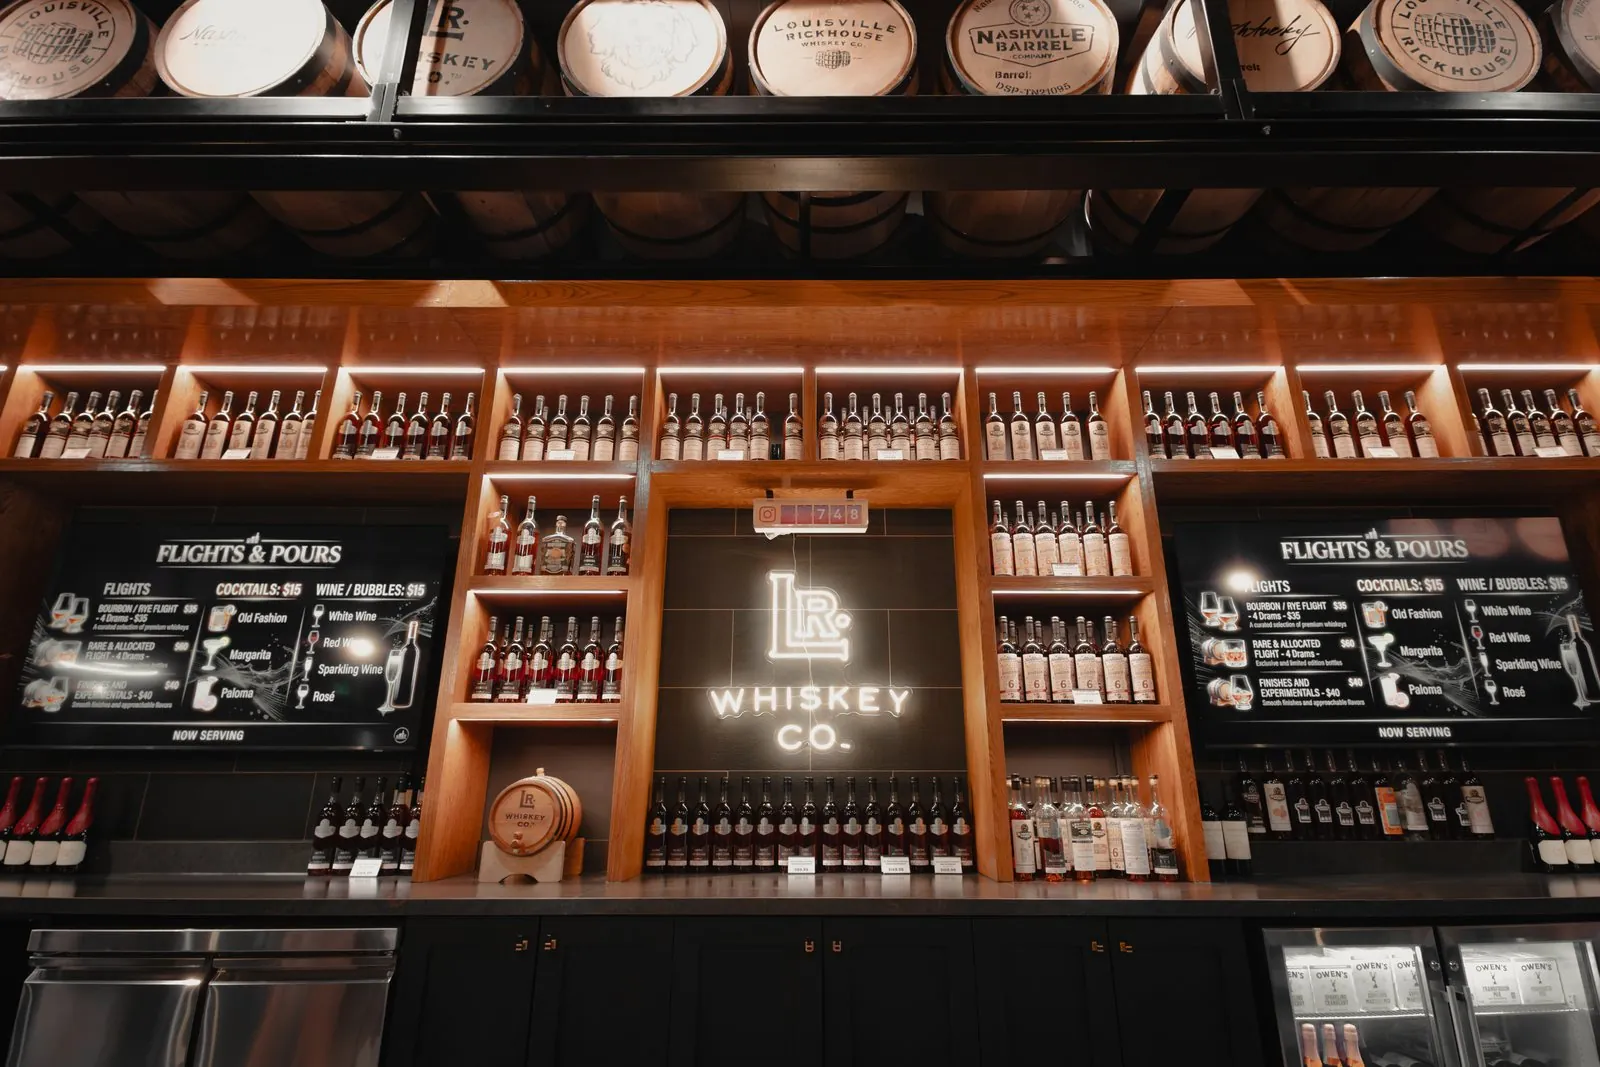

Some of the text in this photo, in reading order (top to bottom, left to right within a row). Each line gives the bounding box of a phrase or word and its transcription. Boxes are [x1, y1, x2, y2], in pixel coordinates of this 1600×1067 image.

[1399, 0, 1506, 29] LOILLE
[774, 19, 897, 33] LOUISVILLE
[786, 30, 884, 42] RICKHOUSE
[977, 27, 1086, 45] NASHVILLE
[996, 41, 1073, 52] BARREL
[417, 51, 496, 71] ISKEY
[1401, 36, 1512, 76] RICKHOUSE
[995, 71, 1032, 79] Barrel:
[817, 509, 859, 520] 748
[156, 545, 342, 563] FLIGHTS & POURS
[1280, 540, 1468, 559] FLIGHTS & POURS
[103, 583, 151, 595] FLIGHTS
[1357, 578, 1444, 592] COCKTAILS: $15
[1456, 579, 1487, 591] WINE
[1495, 578, 1548, 590] BUBBLES:
[1549, 577, 1568, 591] $15
[216, 583, 302, 596] COCKTAILS: $15
[316, 583, 425, 597] WINE / BUBBLES: $15
[98, 604, 132, 613] BOURBON
[153, 604, 179, 613] FLIGHT
[183, 604, 198, 614] $35
[1246, 602, 1281, 611] BOURBON
[1287, 602, 1301, 610] RYE
[1302, 602, 1326, 610] FLIGHT
[1333, 601, 1347, 611] $35
[1481, 606, 1531, 616] White Wine
[106, 614, 129, 622] Drams
[133, 614, 148, 623] $35
[238, 613, 287, 623] Old Fashion
[328, 611, 376, 621] White Wine
[1260, 612, 1281, 620] Drams
[1287, 612, 1300, 620] $35
[1392, 609, 1442, 619] Old Fashion
[323, 637, 340, 647] Red
[1489, 632, 1531, 642] Red Wine
[88, 641, 106, 650] RARE
[114, 642, 155, 650] ALLOCATED
[1253, 640, 1321, 648] RARE & ALLOCATED
[229, 649, 271, 662] Margarita
[1254, 650, 1279, 658] FLIGHT
[1285, 650, 1291, 658] 4
[1292, 650, 1315, 658] Drams
[1400, 645, 1443, 658] Margarita
[318, 664, 383, 676] Sparkling Wine
[1495, 659, 1561, 671] Sparkling Wine
[164, 681, 179, 690] $40
[1259, 678, 1309, 687] FINISHES AND
[1348, 678, 1363, 687] $40
[221, 687, 254, 698] Paloma
[1260, 689, 1320, 697] EXPERIMENTALS
[1326, 688, 1340, 698] $40
[1408, 684, 1442, 695] Paloma
[1502, 686, 1525, 697] Rosé
[138, 690, 153, 700] $40
[313, 690, 335, 702] Rosé
[710, 686, 910, 716] WHISKEY
[172, 730, 244, 740] NOW SERVING
[777, 723, 852, 750] CO.
[1379, 727, 1451, 737] NOW SERVING
[505, 813, 545, 821] WHISKEY
[1356, 962, 1388, 970] OWEN'S
[1475, 964, 1508, 972] OWEN'S
[1521, 963, 1552, 972] OWEN'S
[1316, 970, 1348, 979] OWEN'S
